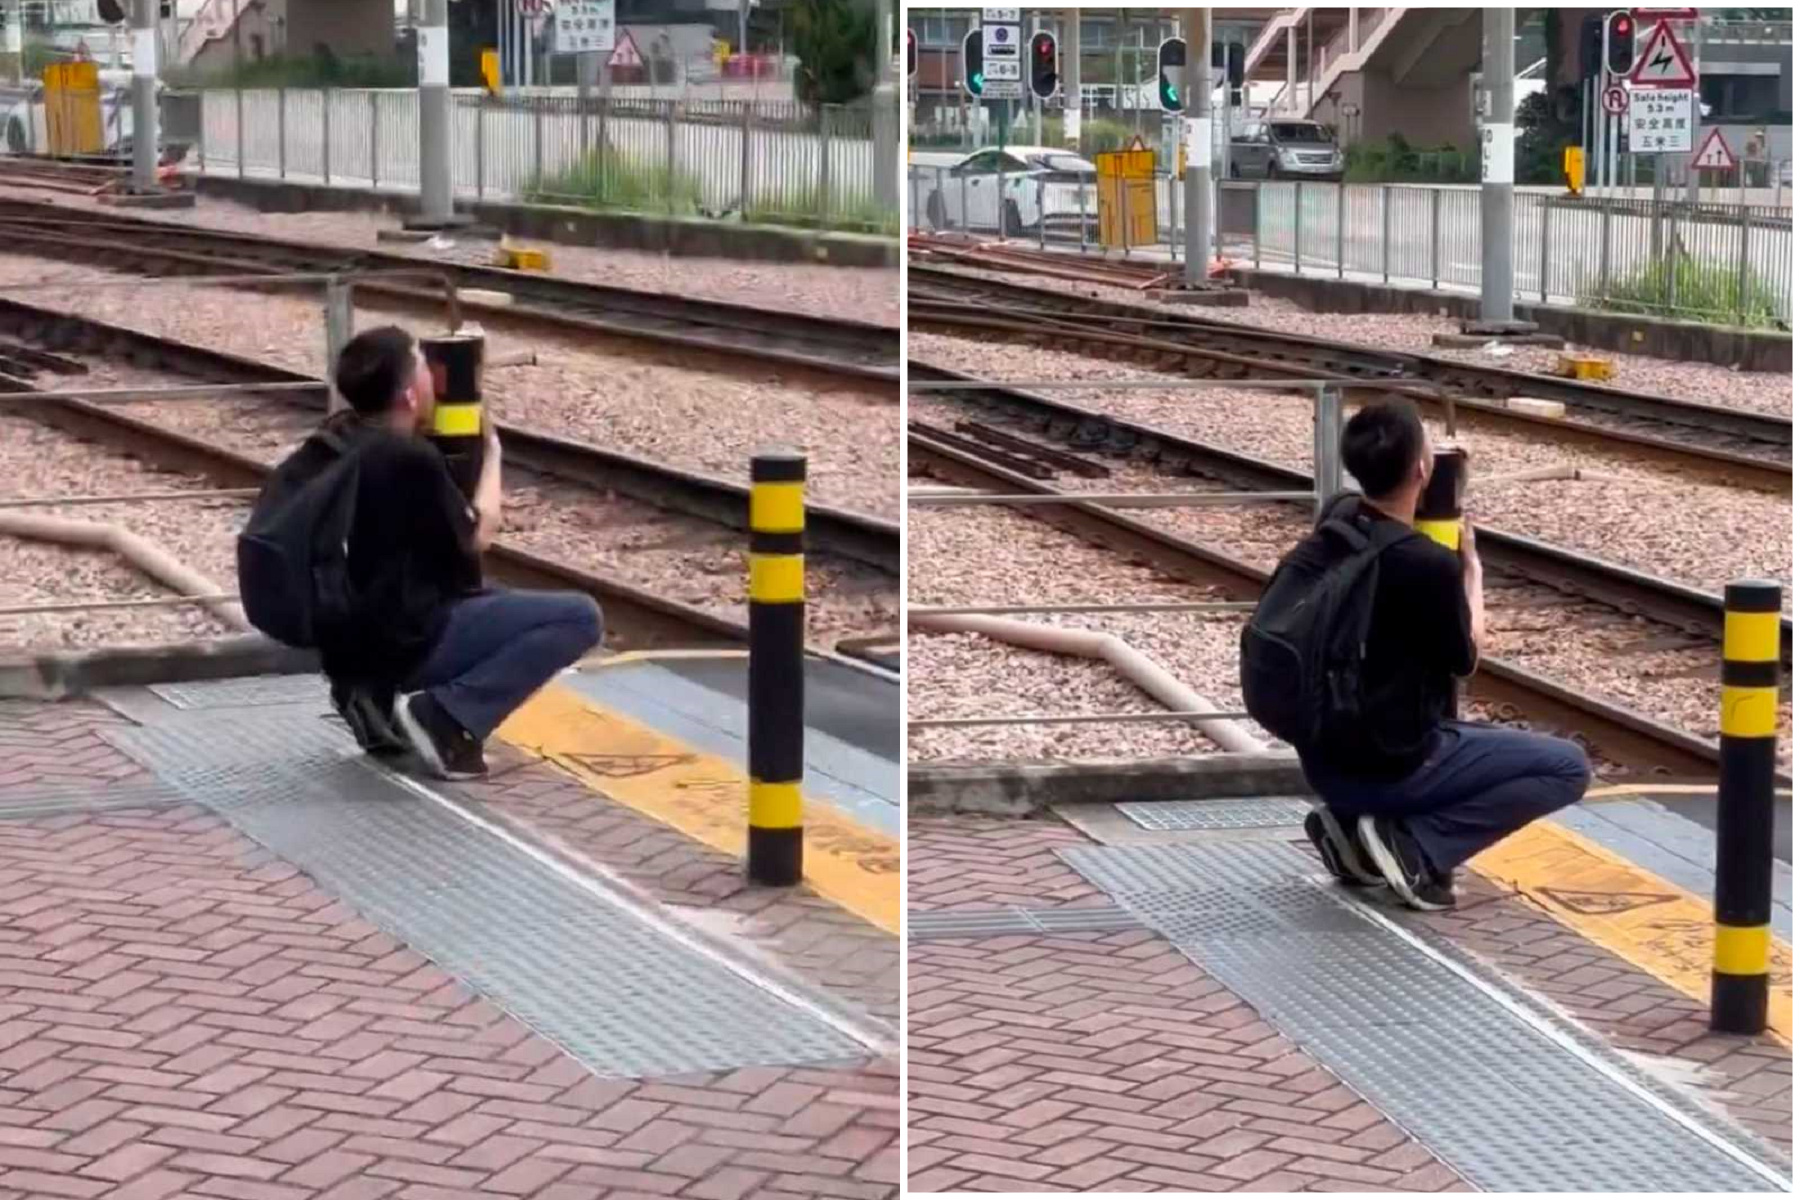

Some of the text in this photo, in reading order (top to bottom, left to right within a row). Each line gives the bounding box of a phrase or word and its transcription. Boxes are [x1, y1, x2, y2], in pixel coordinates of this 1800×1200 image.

[1634, 92, 1689, 103] Safe height
[1634, 117, 1686, 130] 安全高度
